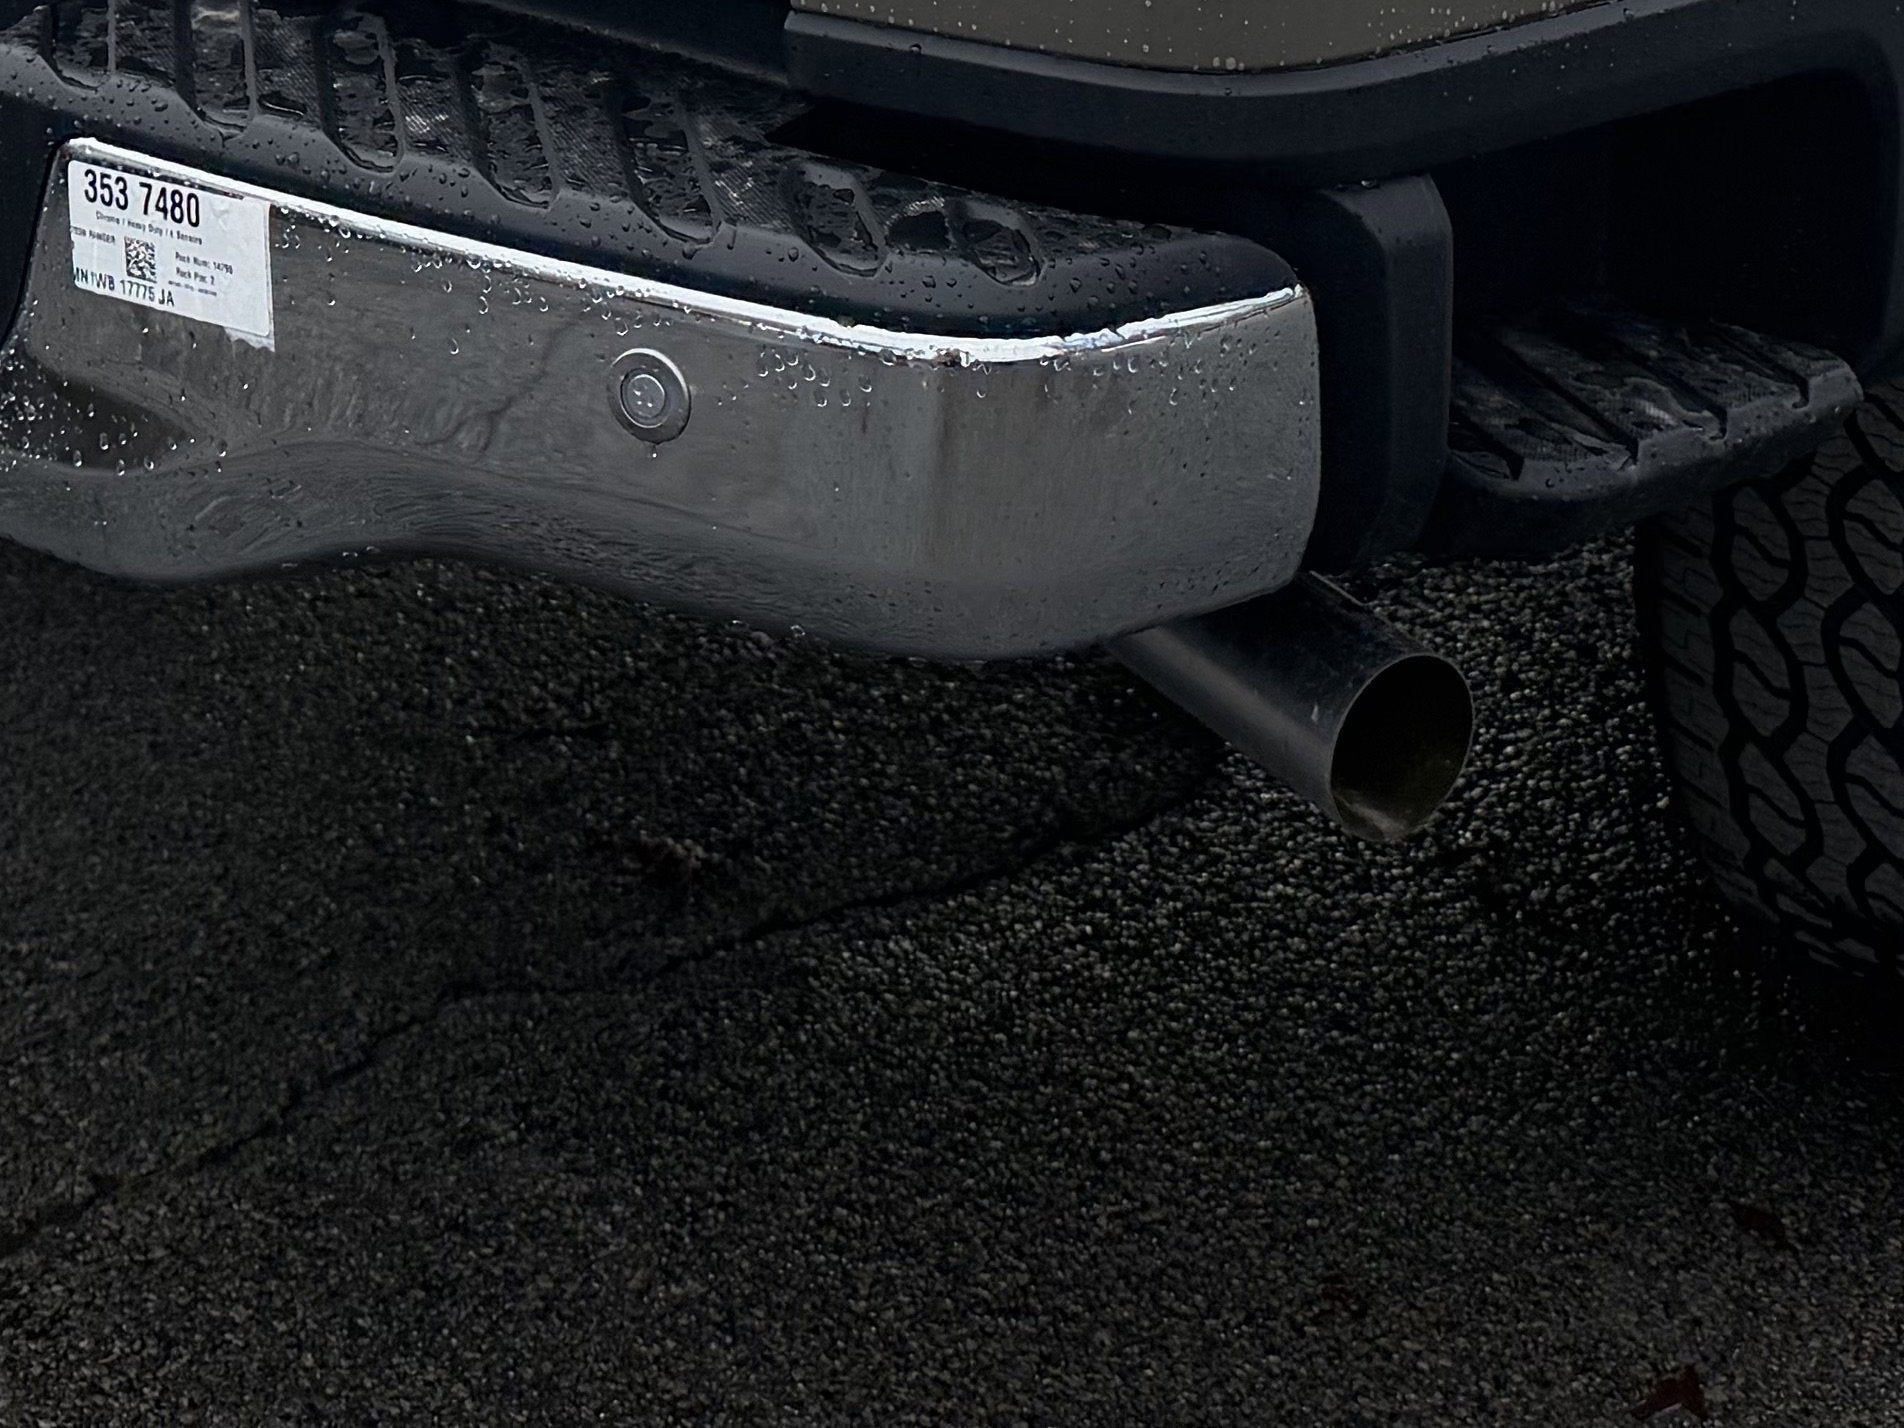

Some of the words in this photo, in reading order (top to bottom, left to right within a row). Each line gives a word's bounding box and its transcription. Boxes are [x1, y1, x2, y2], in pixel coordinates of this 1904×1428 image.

[84, 168, 129, 211] 353
[139, 181, 201, 228] 7480
[158, 289, 175, 308] JA
